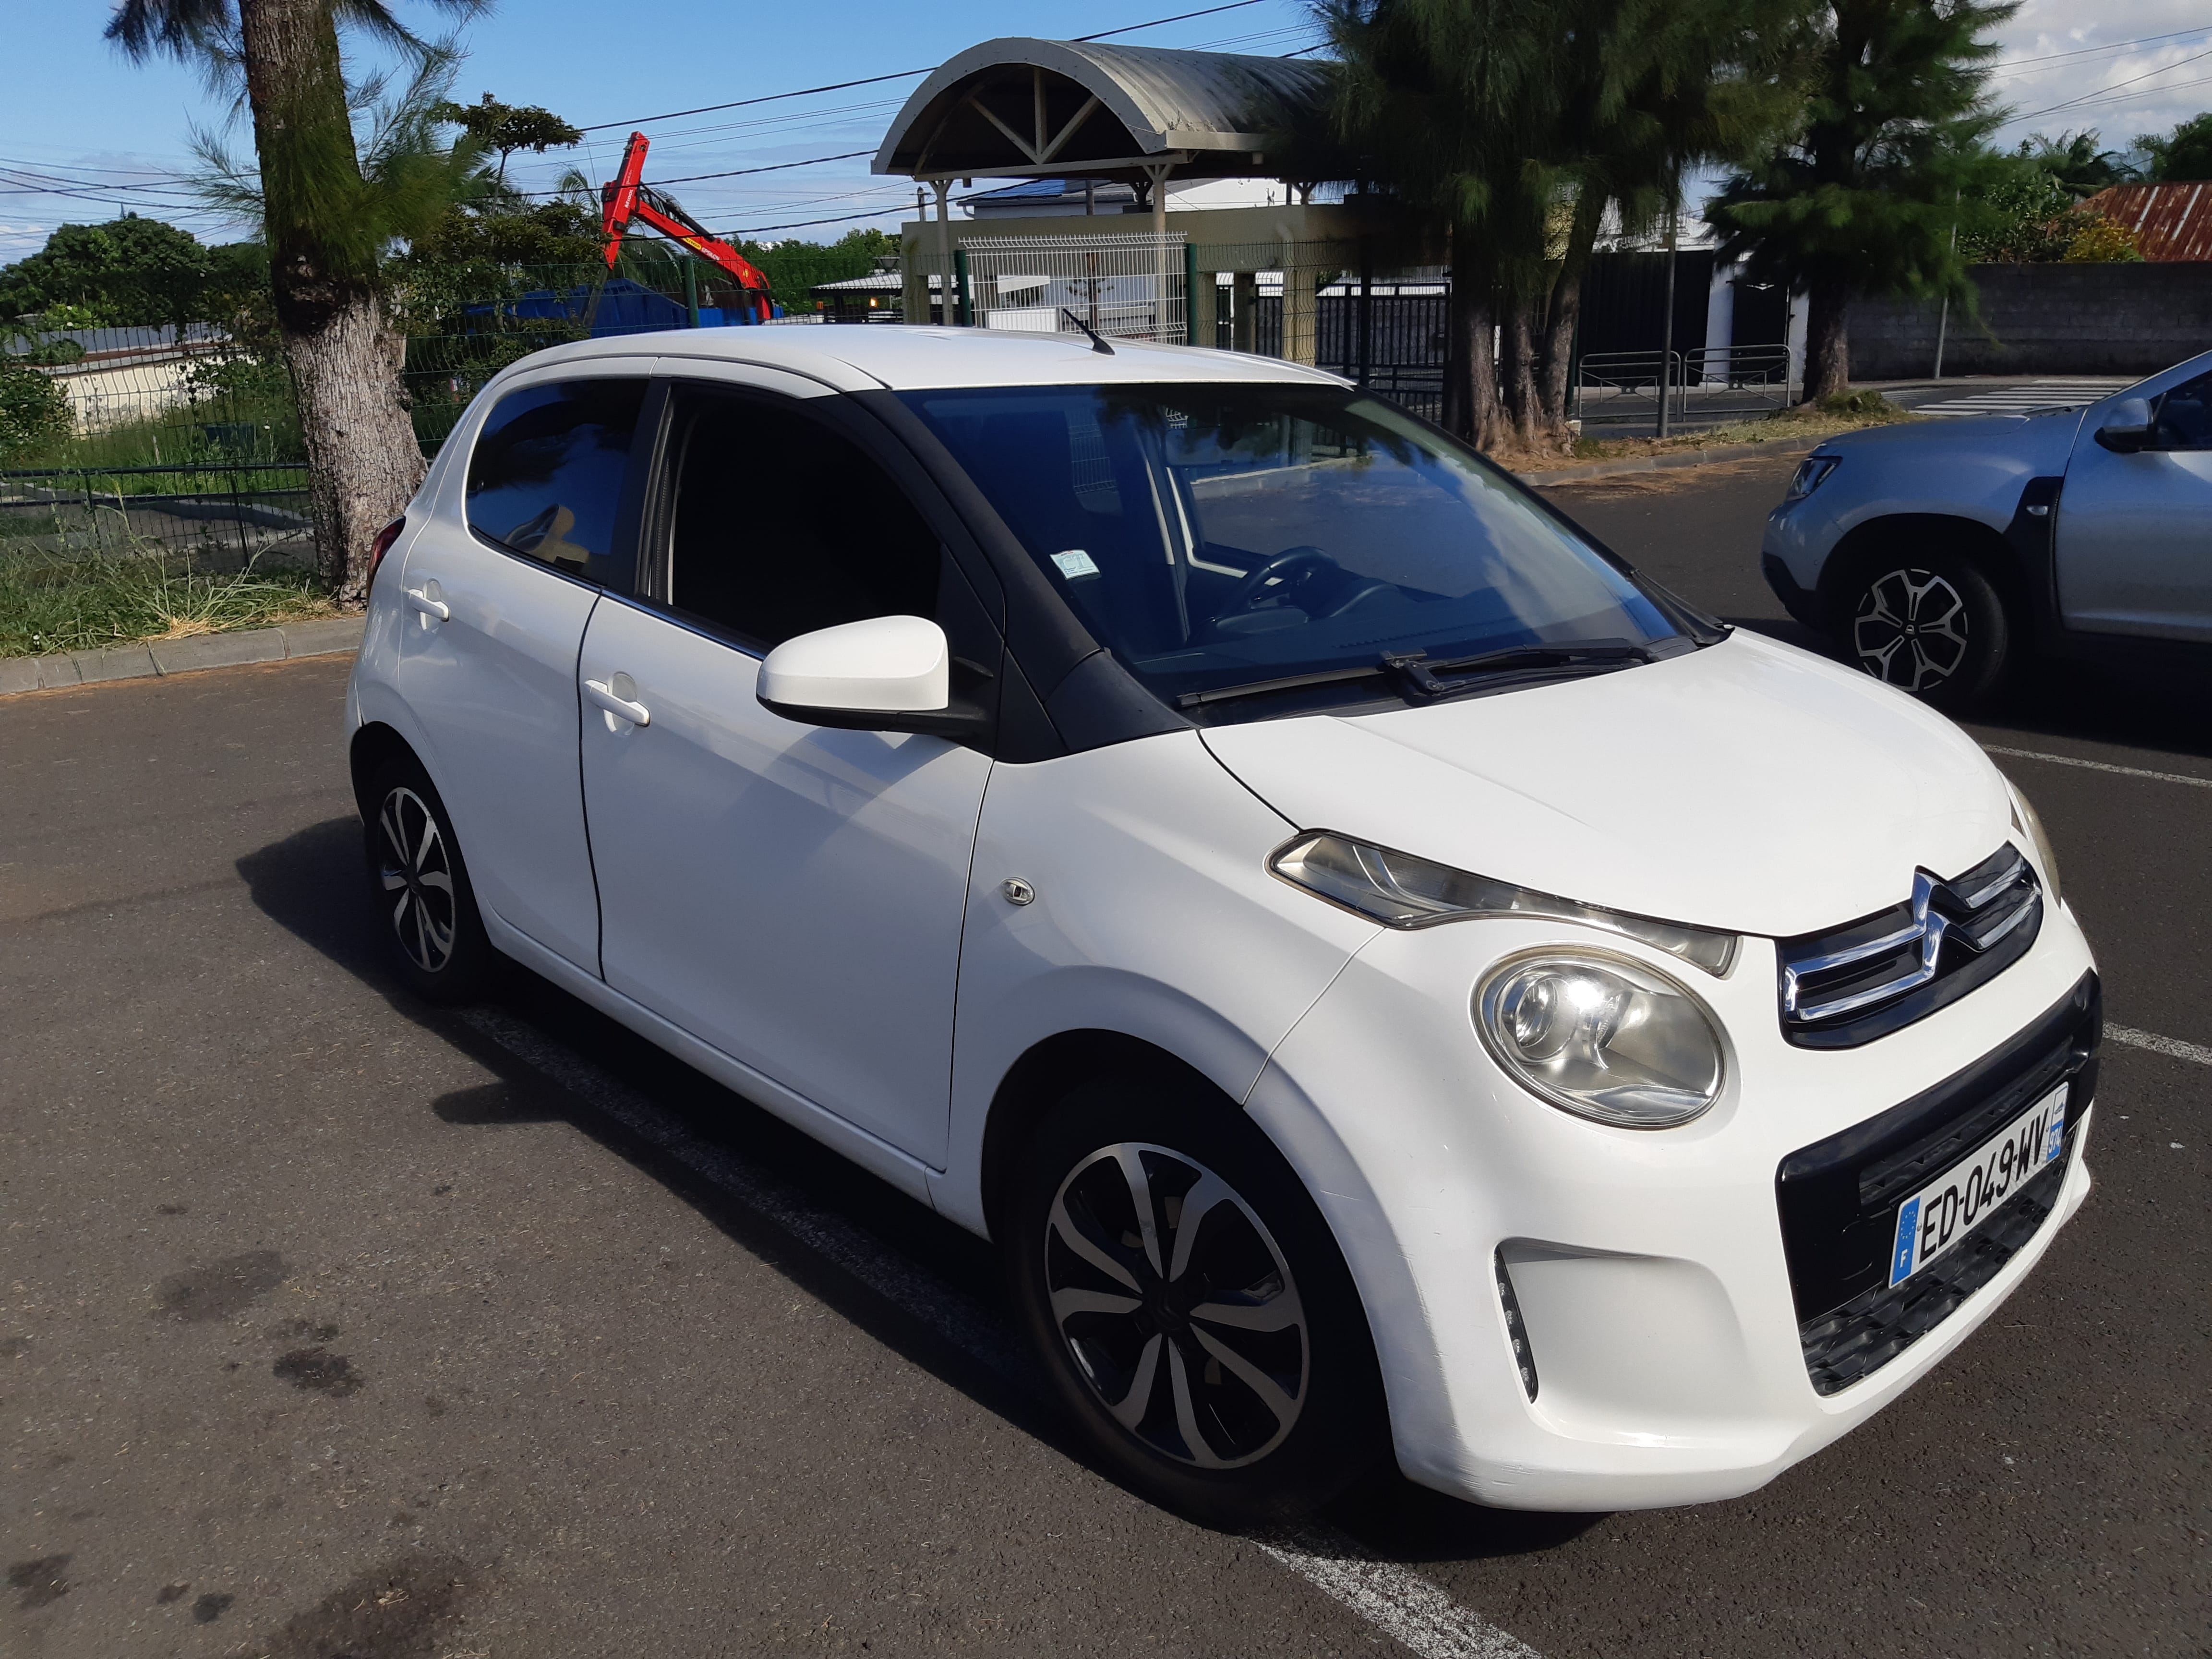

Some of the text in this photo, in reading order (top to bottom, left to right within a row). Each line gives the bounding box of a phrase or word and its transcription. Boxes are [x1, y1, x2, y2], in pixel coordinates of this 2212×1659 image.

[2048, 1126, 2062, 1154] 974
[1919, 1106, 2049, 1264] ED-049-WV
[1899, 1248, 1908, 1268] F
